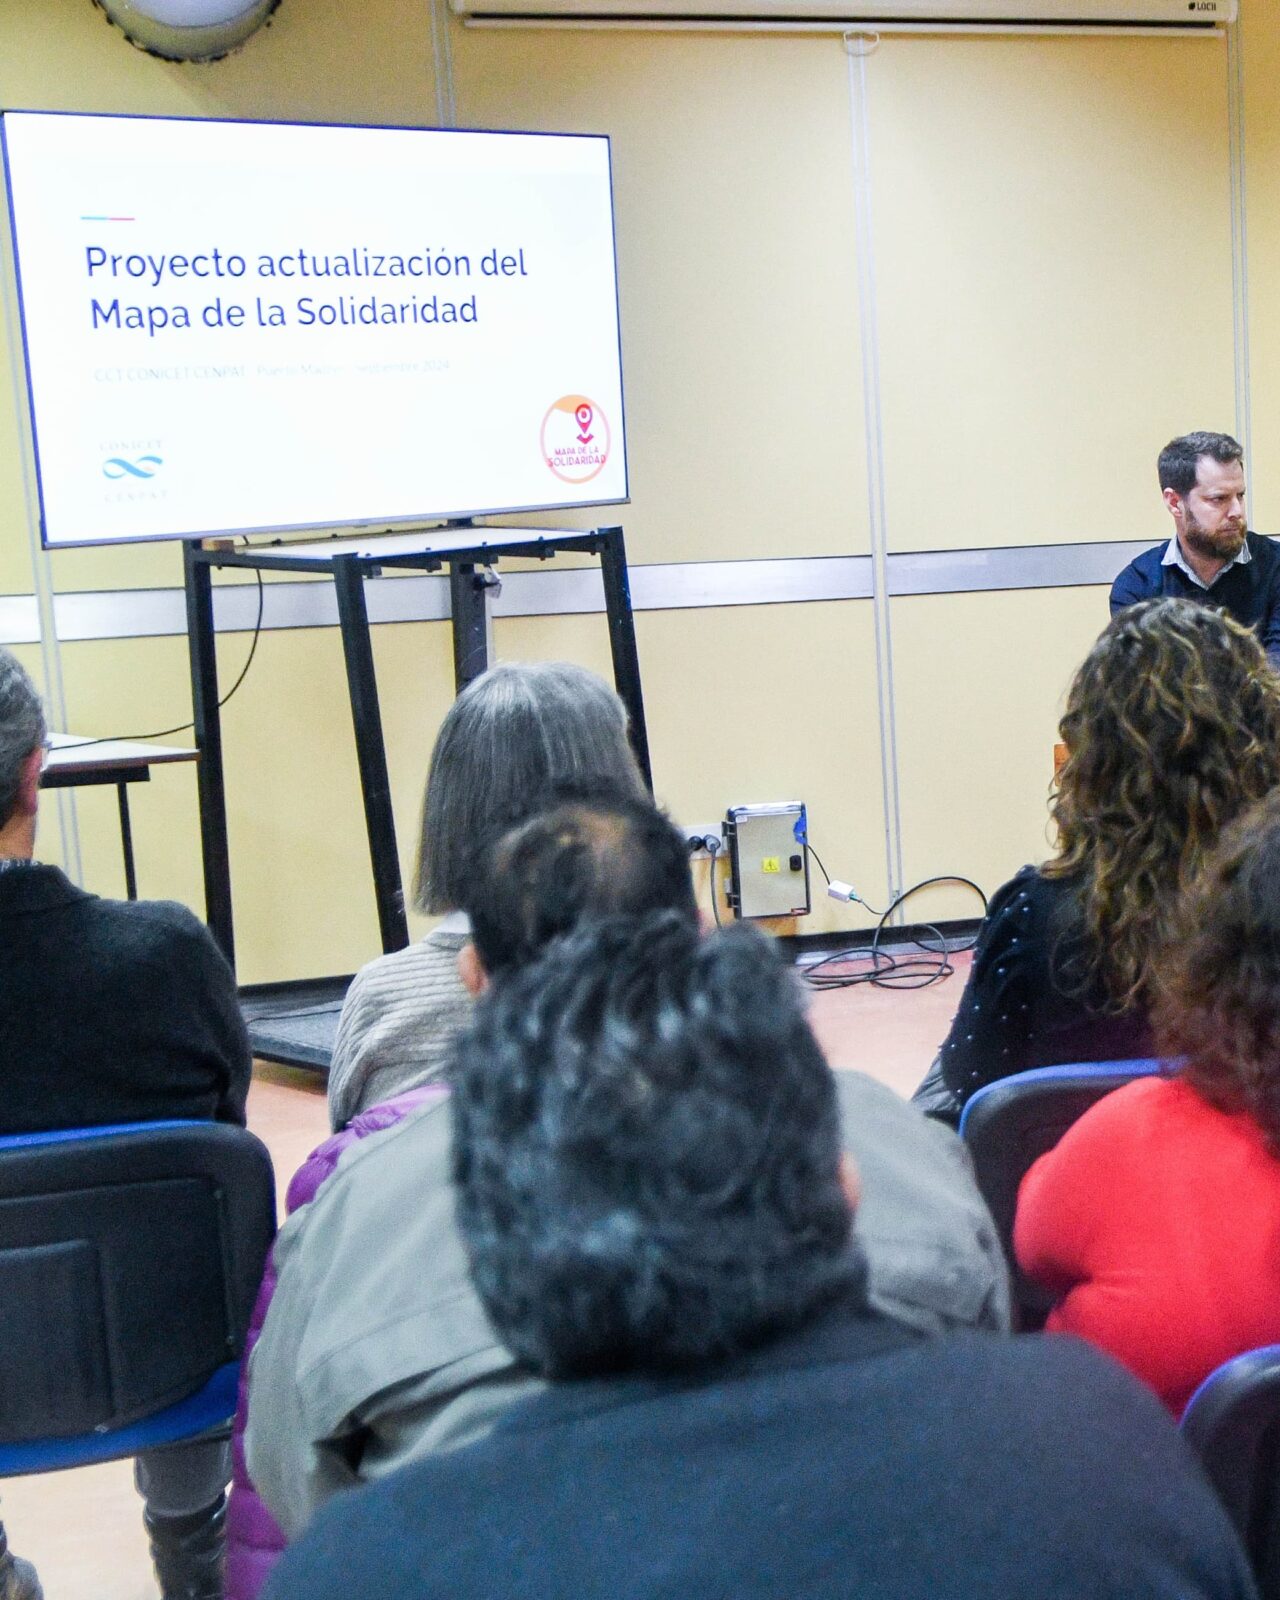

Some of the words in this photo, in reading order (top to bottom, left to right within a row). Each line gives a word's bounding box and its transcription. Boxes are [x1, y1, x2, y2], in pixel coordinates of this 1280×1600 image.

[86, 246, 246, 287] Proyecto
[257, 247, 470, 277] actualización
[481, 247, 528, 276] del
[91, 298, 191, 337] Mapa
[202, 297, 246, 327] de
[256, 296, 287, 326] la
[297, 294, 478, 325] Solidaridad
[546, 454, 607, 467] SOLIDARIDAD
[554, 447, 576, 455] MAPA
[578, 446, 588, 454] DE
[589, 445, 600, 454] LA
